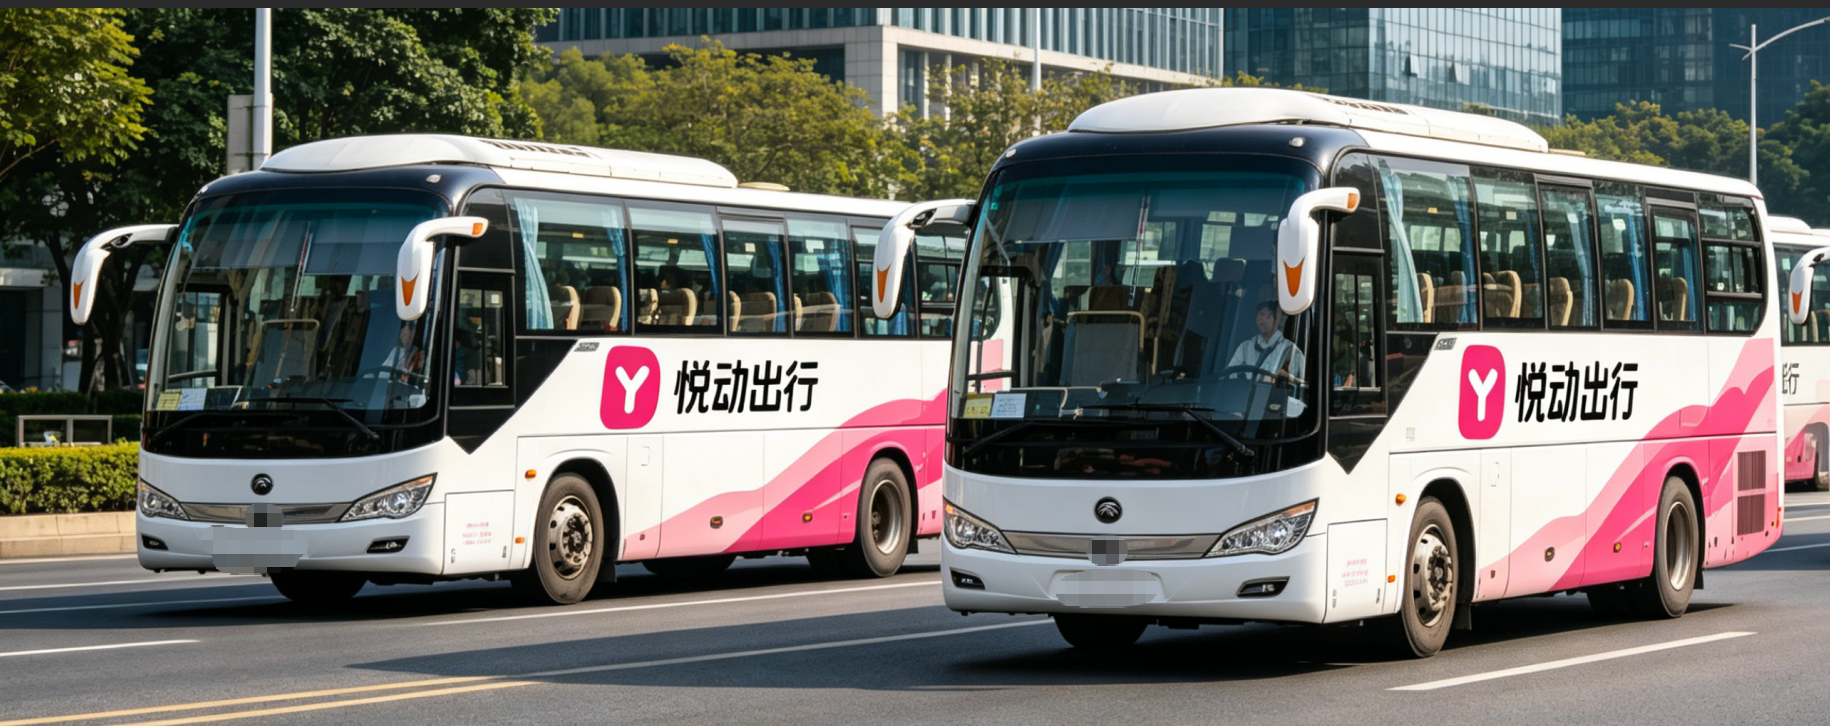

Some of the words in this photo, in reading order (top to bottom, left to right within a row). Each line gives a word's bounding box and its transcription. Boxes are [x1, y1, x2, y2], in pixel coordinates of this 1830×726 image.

[615, 365, 650, 415] Y
[674, 359, 819, 415] 悦动出行
[1468, 368, 1498, 422] Y
[1514, 360, 1639, 423] 悦动出行
